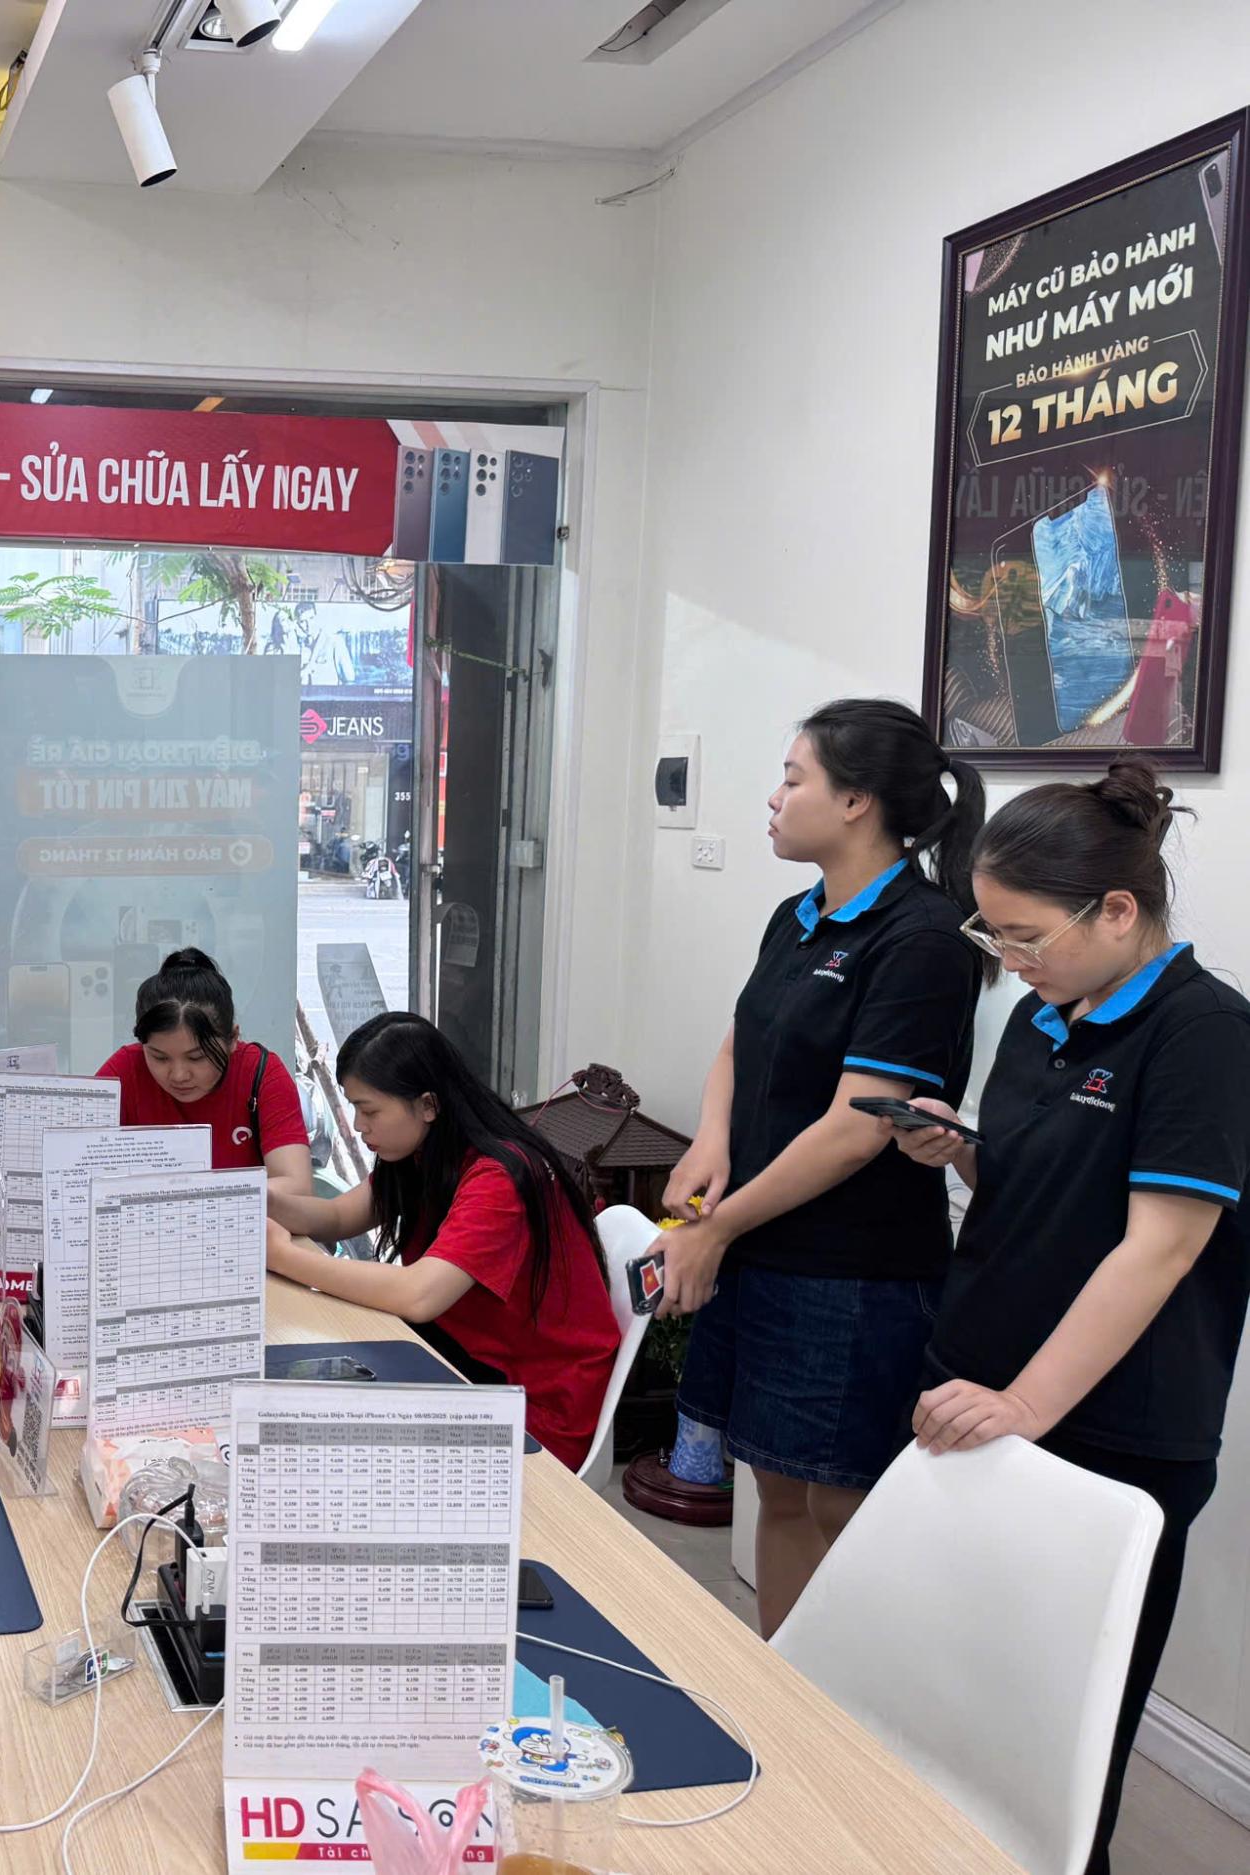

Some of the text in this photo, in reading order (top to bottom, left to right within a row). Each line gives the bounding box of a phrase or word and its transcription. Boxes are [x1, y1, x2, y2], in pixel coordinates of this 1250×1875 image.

[987, 222, 1197, 317] MÁY CŨ BẢO HÀNH
[985, 262, 1194, 362] NHƯ MÁY MỚI
[1015, 335, 1150, 389] BẢO HÀNH VÀNG
[987, 361, 1180, 446] 12 THÁNG
[20, 440, 90, 503] SỬA
[98, 448, 192, 507] CHỮA
[199, 448, 266, 509] LẤY
[273, 465, 360, 513] NGAY
[326, 717, 384, 736] JEANS
[395, 792, 411, 801] 355
[240, 1796, 305, 1838] HD
[318, 1846, 342, 1858] Tài
